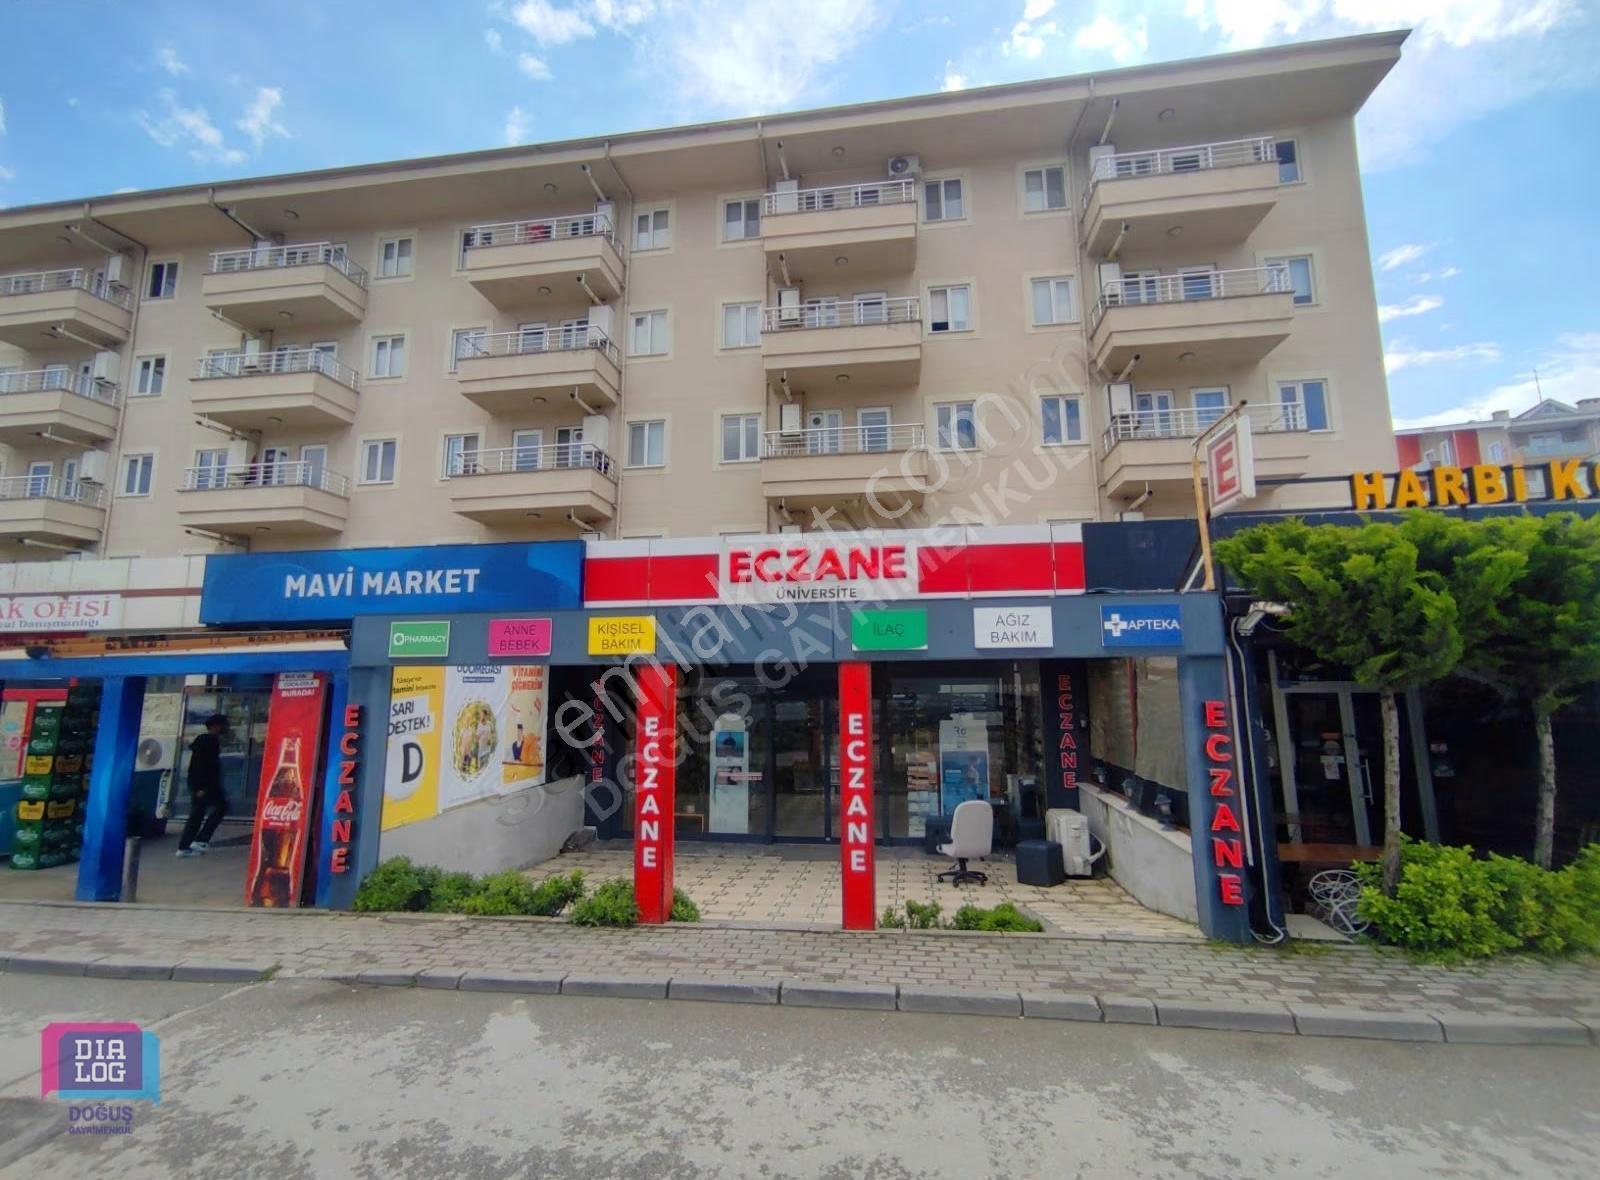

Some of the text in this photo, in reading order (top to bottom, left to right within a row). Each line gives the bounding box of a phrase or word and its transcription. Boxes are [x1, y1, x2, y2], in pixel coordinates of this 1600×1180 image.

[1214, 441, 1238, 497] E
[1549, 458, 1600, 500] K
[729, 544, 908, 583] ECZANE
[284, 566, 481, 598] MAVİ MARKET
[776, 586, 857, 600] ÜNİVERSİTE
[33, 595, 112, 619] OFİSİ
[503, 625, 537, 636] ANNE
[597, 622, 645, 637] KİŞİSEL
[873, 622, 905, 637] İLAÇ
[995, 613, 1030, 627] AĞIZ
[1128, 619, 1181, 630] APTEKA
[404, 634, 447, 644] PHARMACY
[500, 639, 540, 651] BEBEK
[601, 638, 641, 650] BAKIM
[990, 631, 1038, 644] BAKIM
[391, 701, 415, 717] SARI
[388, 715, 430, 736] DESTEK!
[1057, 674, 1079, 789] ECZANE
[402, 742, 424, 783] D
[331, 704, 361, 873] ECZANE
[640, 716, 661, 868] ECZANE
[846, 713, 869, 872] ECZANE
[1203, 700, 1245, 905] ECZANE
